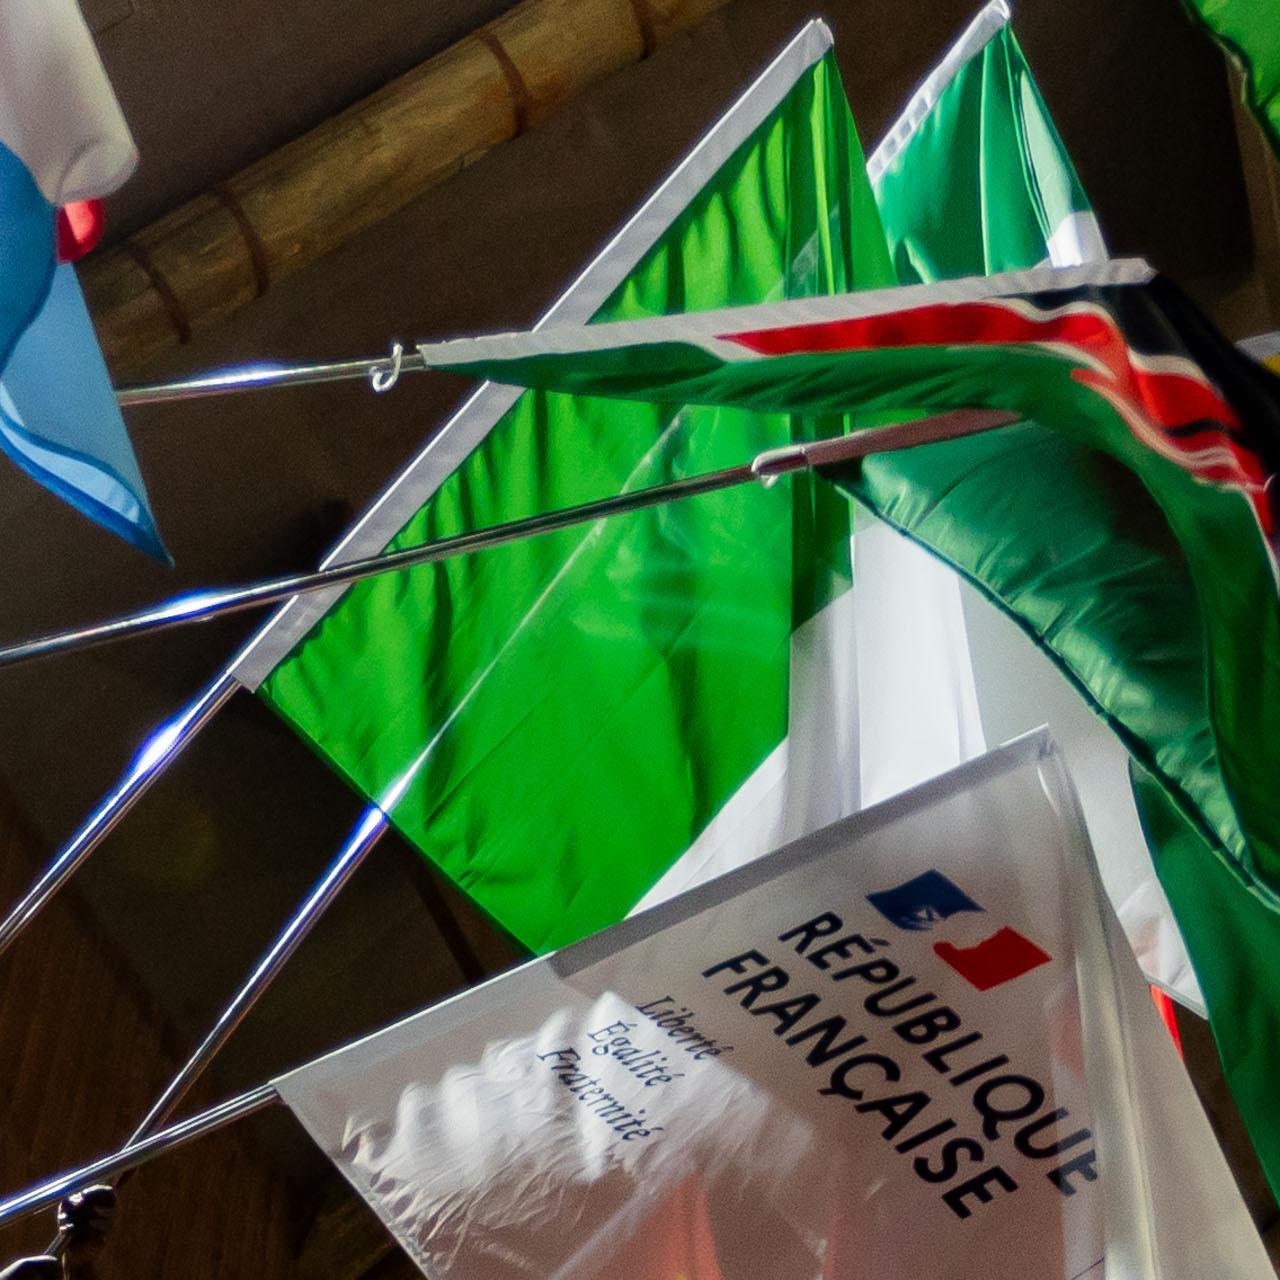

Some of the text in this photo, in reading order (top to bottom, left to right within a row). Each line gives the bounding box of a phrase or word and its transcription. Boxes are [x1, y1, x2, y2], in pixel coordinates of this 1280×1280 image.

[586, 1020, 685, 1087] Égalité
[635, 995, 734, 1061] Liberté
[778, 911, 1098, 1197] RÉPUBLIQUE
[536, 1047, 665, 1141] Fraternité
[703, 948, 1019, 1219] FRANÇAISE
